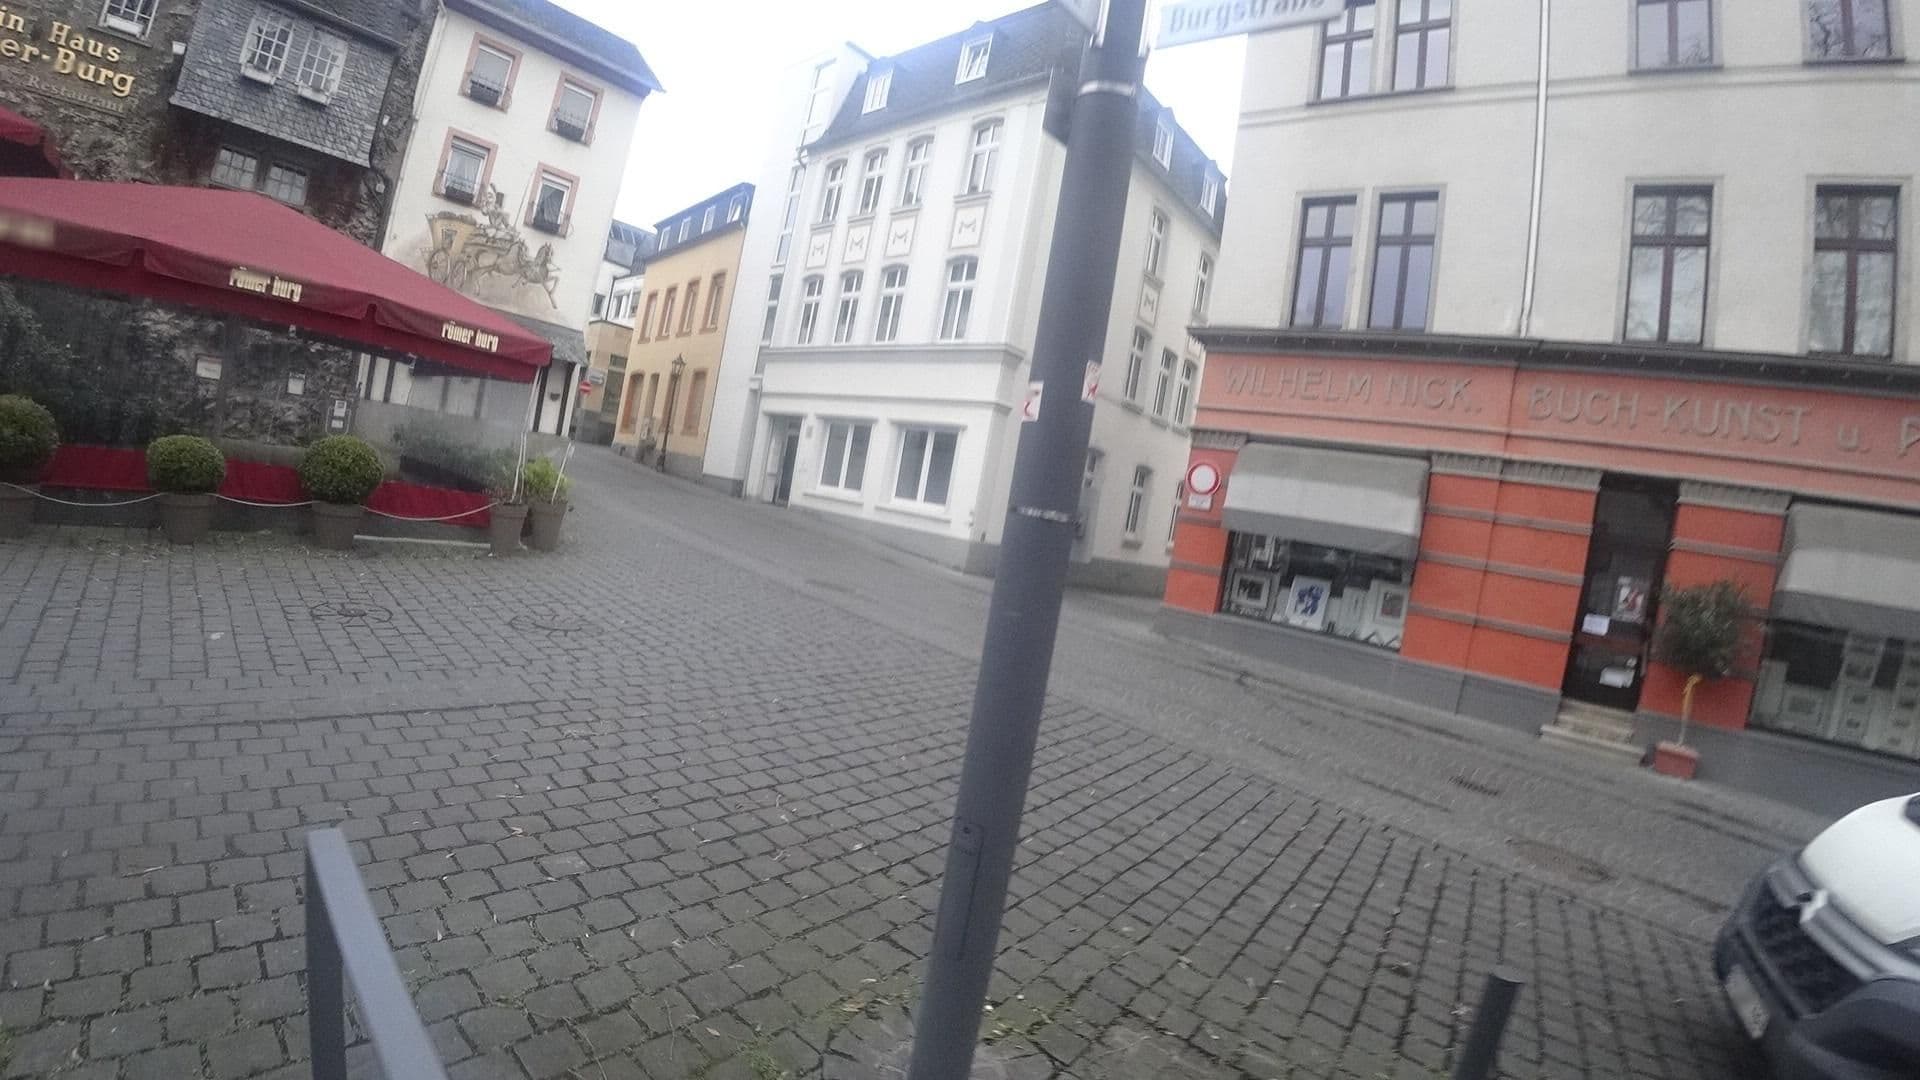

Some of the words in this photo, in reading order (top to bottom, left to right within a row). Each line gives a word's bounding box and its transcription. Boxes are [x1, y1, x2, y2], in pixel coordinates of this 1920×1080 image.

[48, 21, 122, 63] Haus
[272, 276, 302, 304] burg
[441, 320, 475, 345] römer
[475, 329, 499, 353] burg
[1225, 365, 1374, 404] WILHELM
[1527, 385, 1811, 447] BUCH-KUNST
